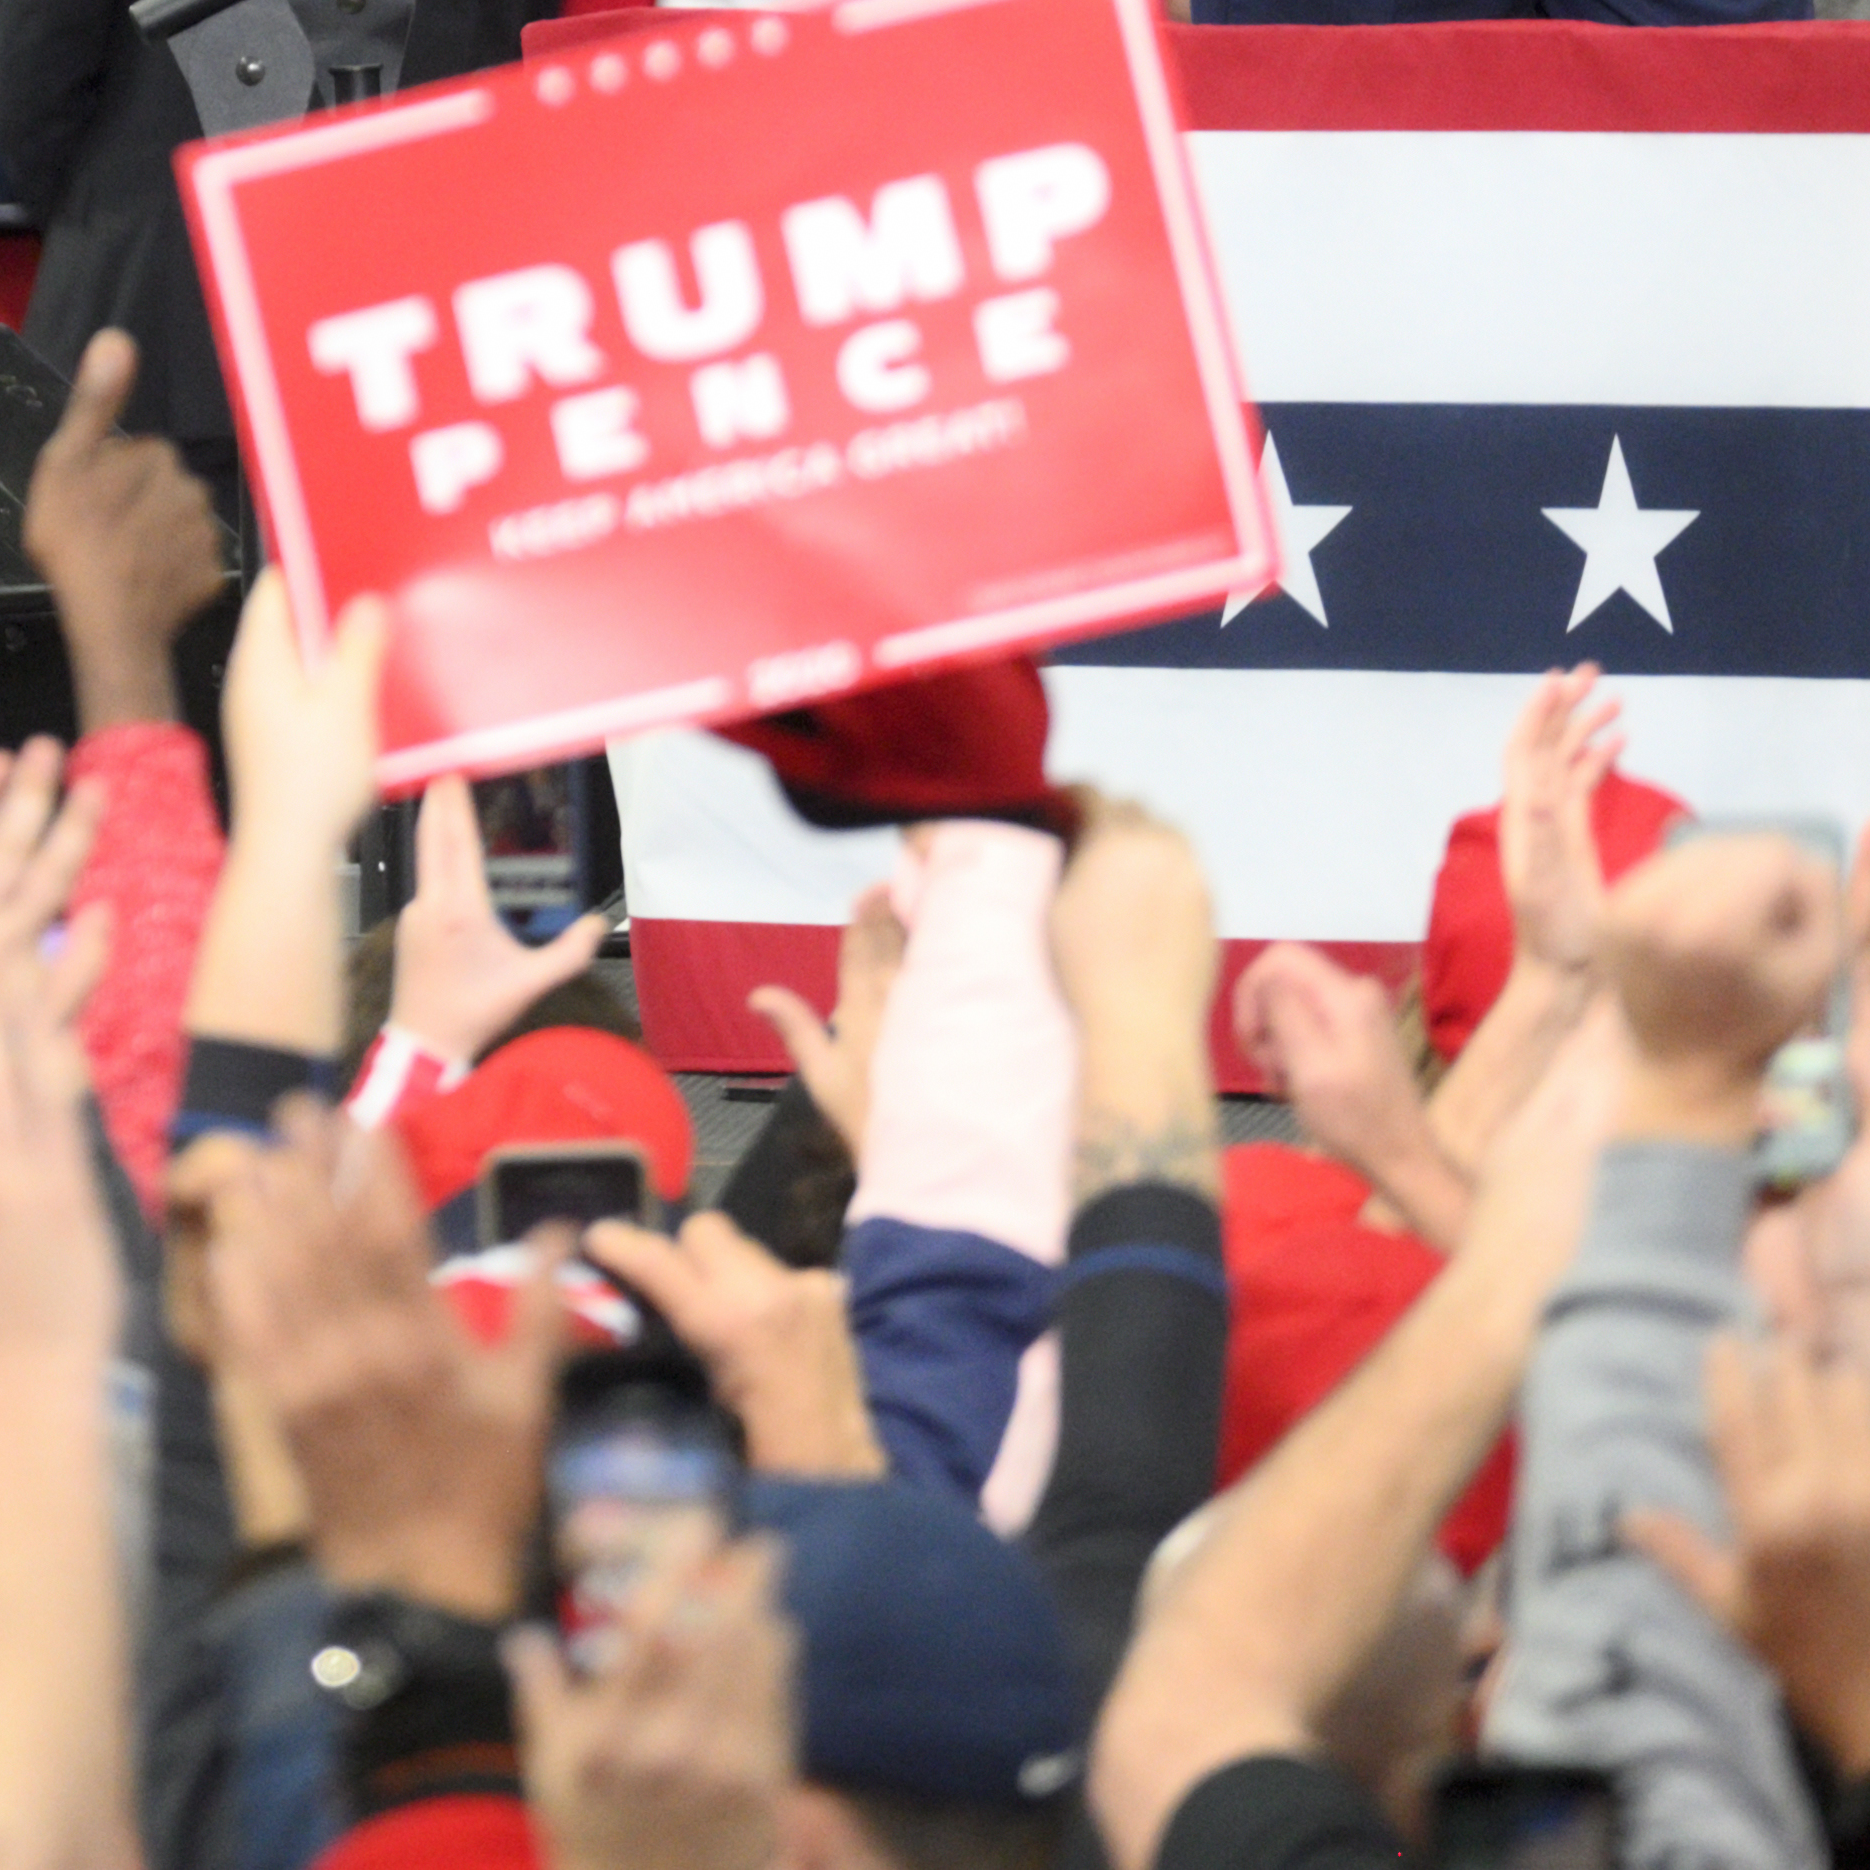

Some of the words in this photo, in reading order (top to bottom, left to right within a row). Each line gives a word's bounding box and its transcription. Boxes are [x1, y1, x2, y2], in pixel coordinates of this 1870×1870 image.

[307, 141, 1115, 434] TRUMP
[409, 286, 1073, 518] PENCE
[623, 441, 844, 533] AMERICA
